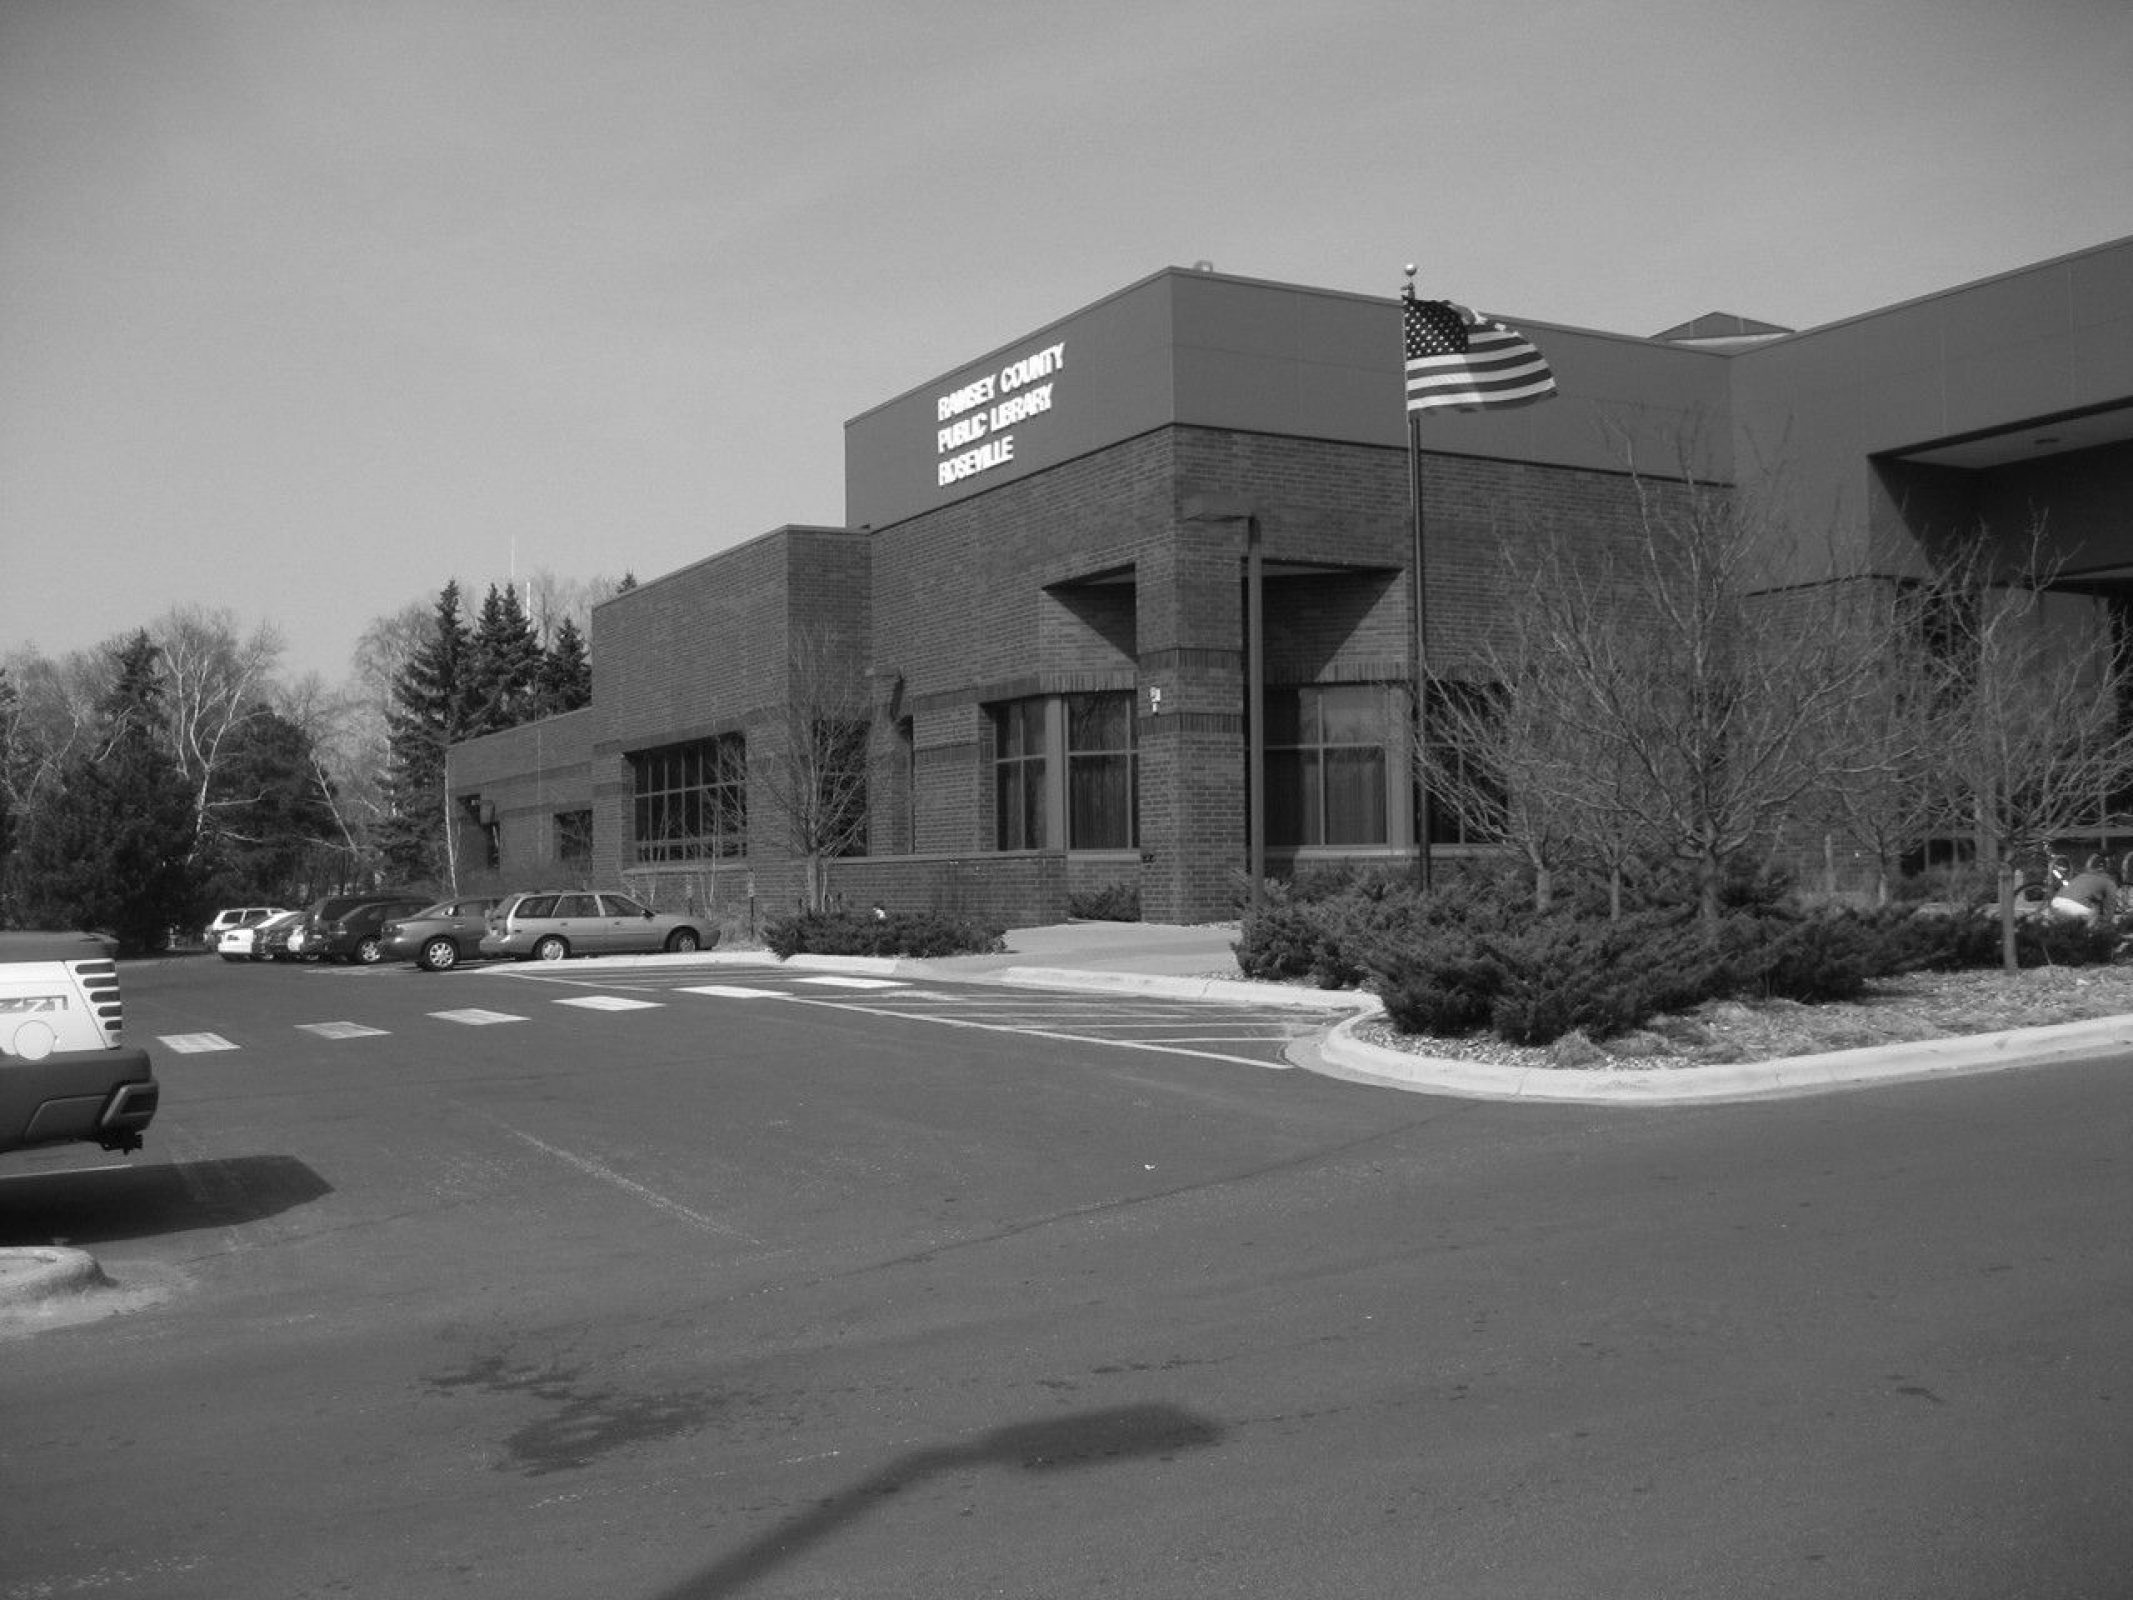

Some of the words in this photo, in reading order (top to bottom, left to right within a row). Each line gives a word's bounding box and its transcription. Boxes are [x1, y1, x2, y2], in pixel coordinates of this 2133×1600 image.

[937, 374, 996, 422] RAMSEY
[1000, 342, 1065, 393] COUNTY
[937, 412, 988, 453] PUBLIC
[990, 382, 1054, 432] LIBRARY
[937, 435, 1014, 486] ROSEVILLE
